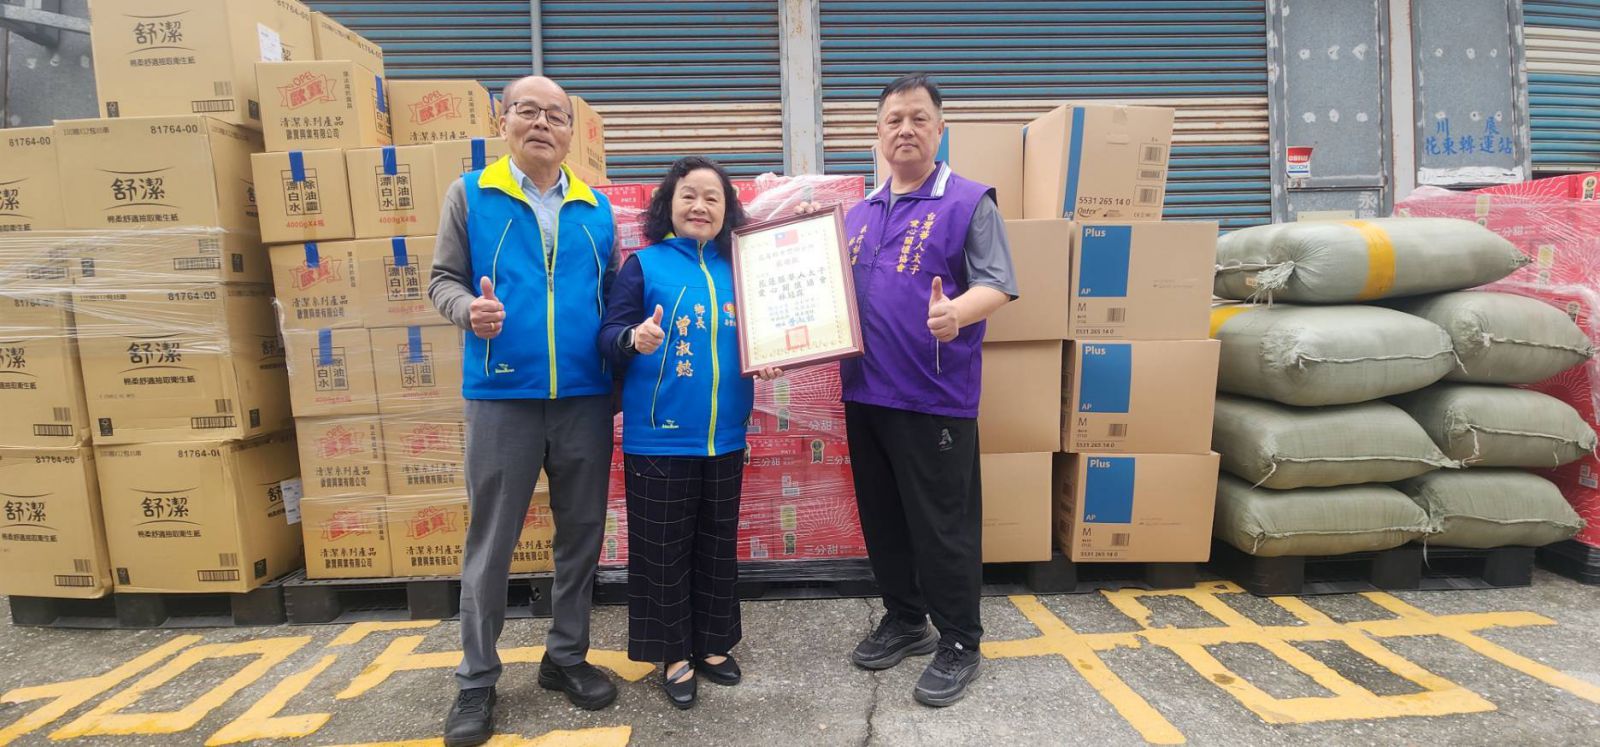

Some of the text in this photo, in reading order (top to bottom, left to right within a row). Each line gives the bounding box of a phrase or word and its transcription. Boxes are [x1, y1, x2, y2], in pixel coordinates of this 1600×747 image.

[133, 21, 184, 45] 舒潔
[150, 124, 199, 135] 81764-00
[9, 137, 51, 147] 81764-00
[111, 178, 166, 201] 舒潔
[1079, 197, 1097, 205] 5531
[1099, 197, 1113, 206] 265
[1115, 197, 1124, 206] 14
[1085, 228, 1106, 237] Plus
[168, 291, 216, 301] 81764-00
[1077, 303, 1087, 312] M
[675, 314, 694, 377] 曾淑懿
[1085, 346, 1106, 355] Plus
[128, 342, 182, 365] 舒潔
[1078, 418, 1088, 427] M
[1090, 459, 1111, 468] Plus
[4, 500, 47, 522] 舒潔
[141, 497, 190, 518] 舒潔
[1082, 527, 1092, 536] M
